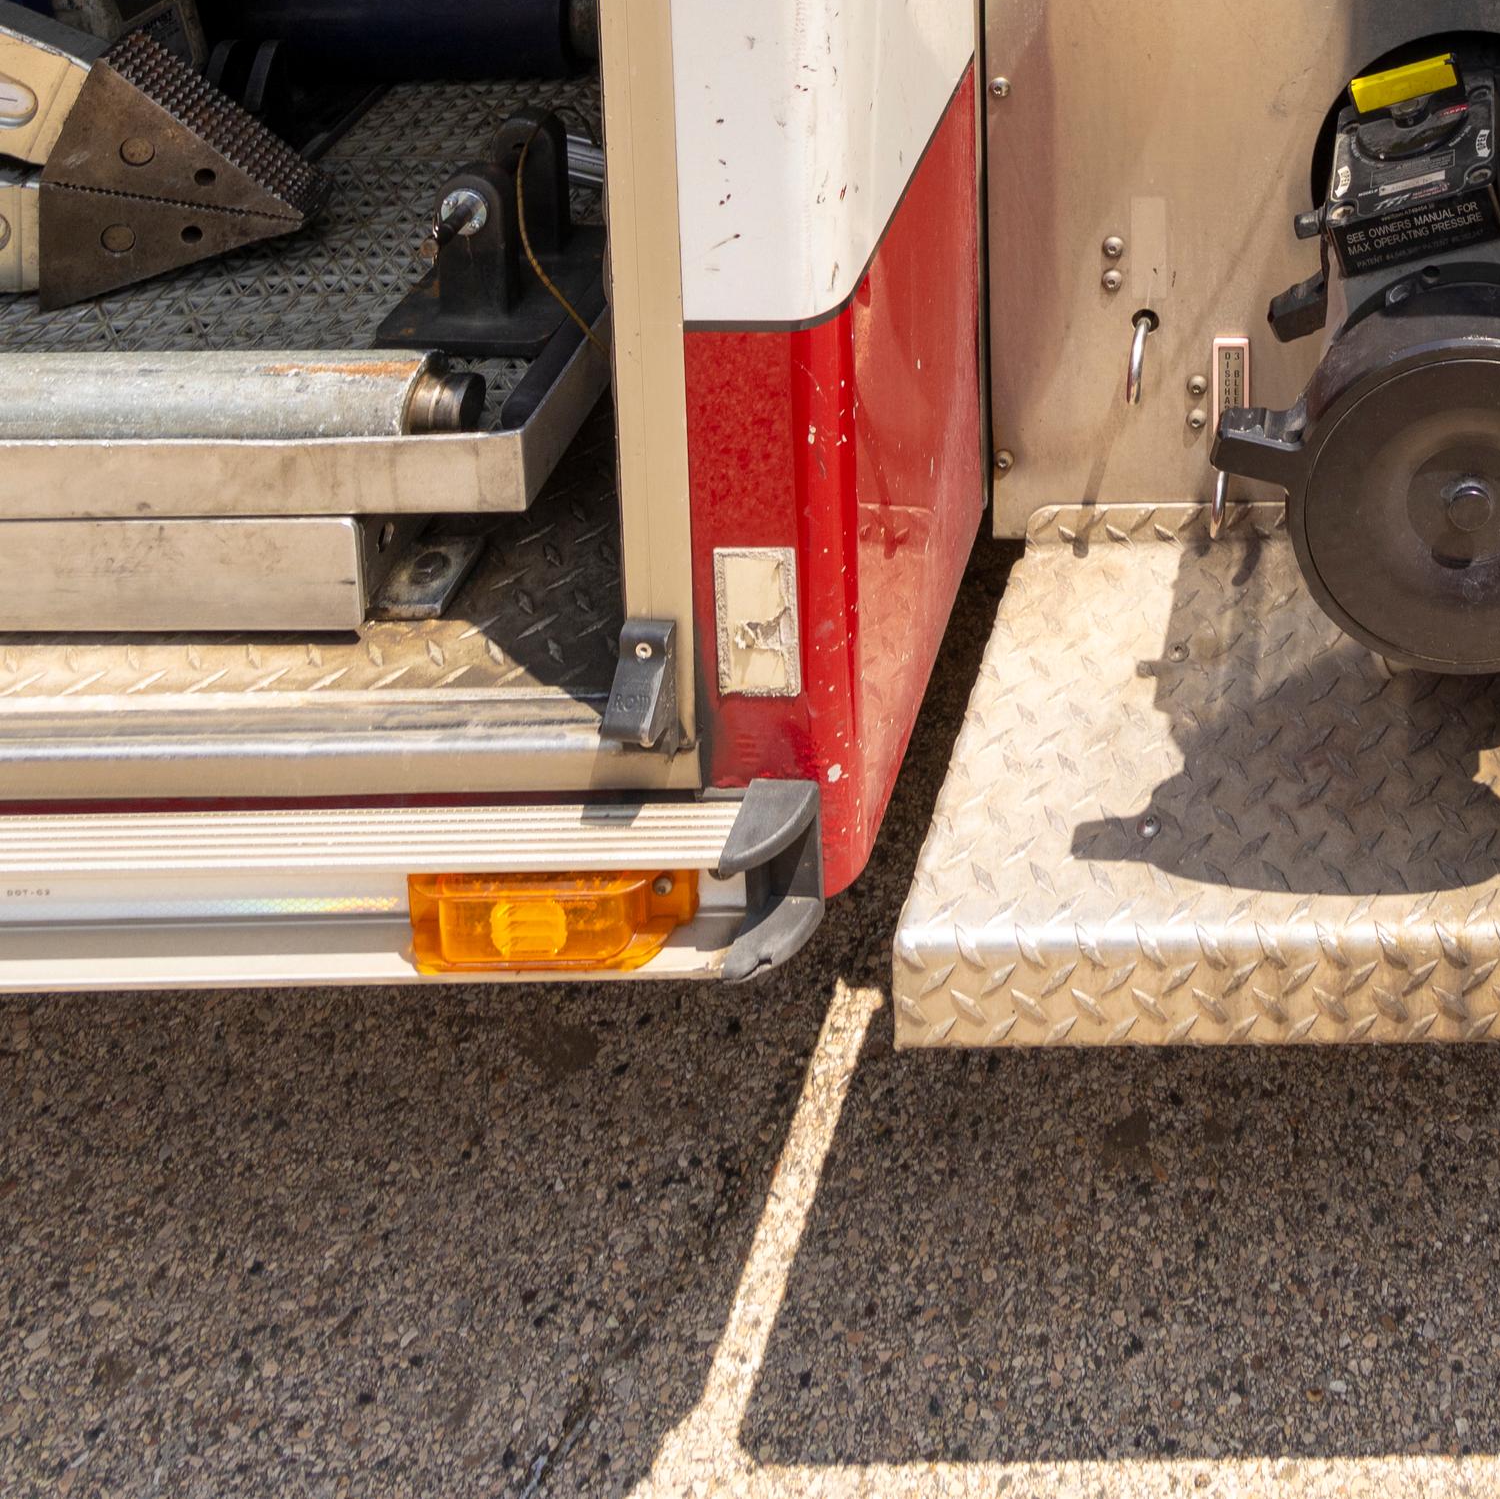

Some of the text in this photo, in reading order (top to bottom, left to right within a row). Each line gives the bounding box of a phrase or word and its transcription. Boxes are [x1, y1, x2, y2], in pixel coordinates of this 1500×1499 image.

[1347, 231, 1366, 244] SEE
[1368, 220, 1412, 238] OWNERS
[1414, 208, 1455, 226] MANUAL
[1457, 201, 1479, 214] FOR
[1347, 242, 1371, 256] MAX
[1374, 227, 1429, 249] OPERATING
[1432, 212, 1483, 233] PRESSURE
[1356, 255, 1383, 268] PATENT
[1234, 352, 1240, 360] 3
